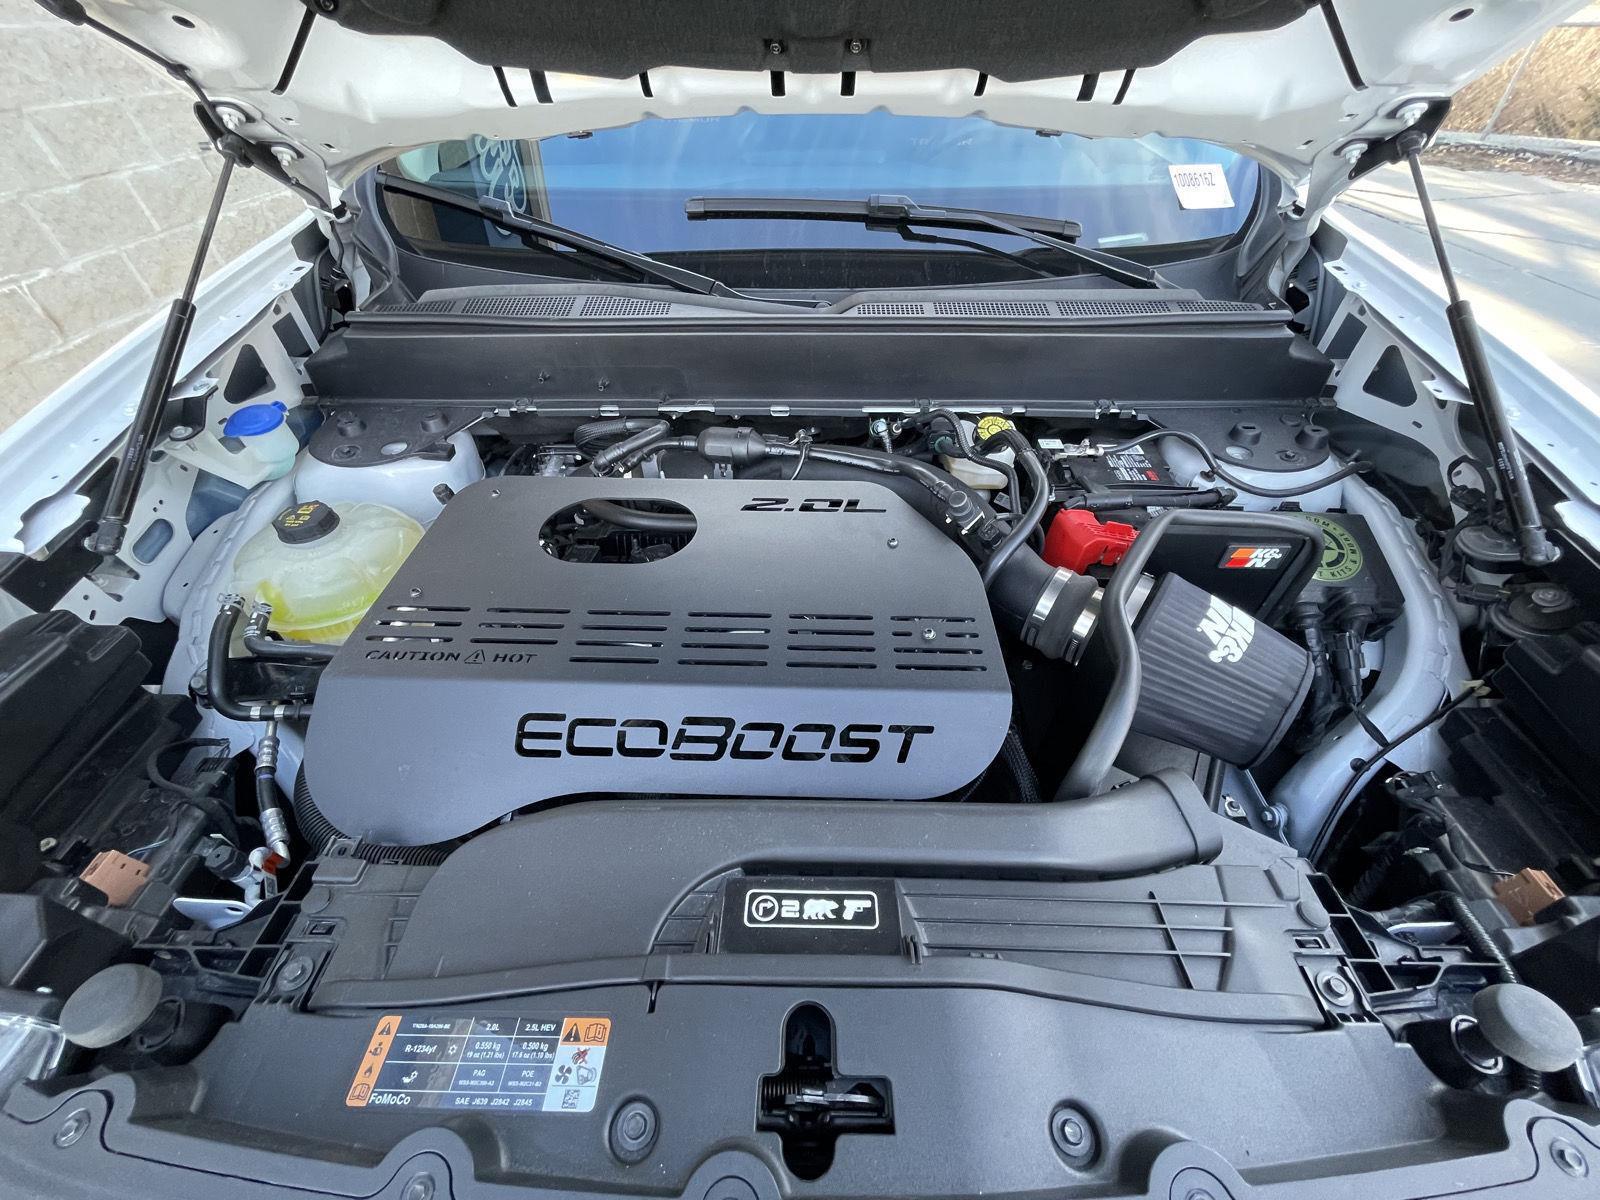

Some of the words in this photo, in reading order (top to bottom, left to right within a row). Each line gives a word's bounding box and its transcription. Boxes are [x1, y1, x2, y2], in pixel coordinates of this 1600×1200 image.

[741, 497, 888, 513] 2.0L
[1329, 566, 1352, 578] KITS
[365, 650, 461, 662] CAUTION
[492, 653, 538, 663] HOT
[514, 712, 935, 764] ECOBOOST
[485, 1023, 500, 1031] 2.0L
[524, 1023, 539, 1031] 2.5L
[540, 1023, 556, 1032] HEV
[404, 1044, 438, 1055] R-1234yf
[475, 1041, 492, 1050] 0.550
[492, 1042, 501, 1052] kg
[522, 1042, 540, 1050] 0.500
[540, 1042, 549, 1052] kg
[472, 1069, 486, 1077] PAG
[521, 1070, 535, 1078] POE
[368, 1093, 411, 1105] FoMoCo
[455, 1097, 470, 1105] SAE
